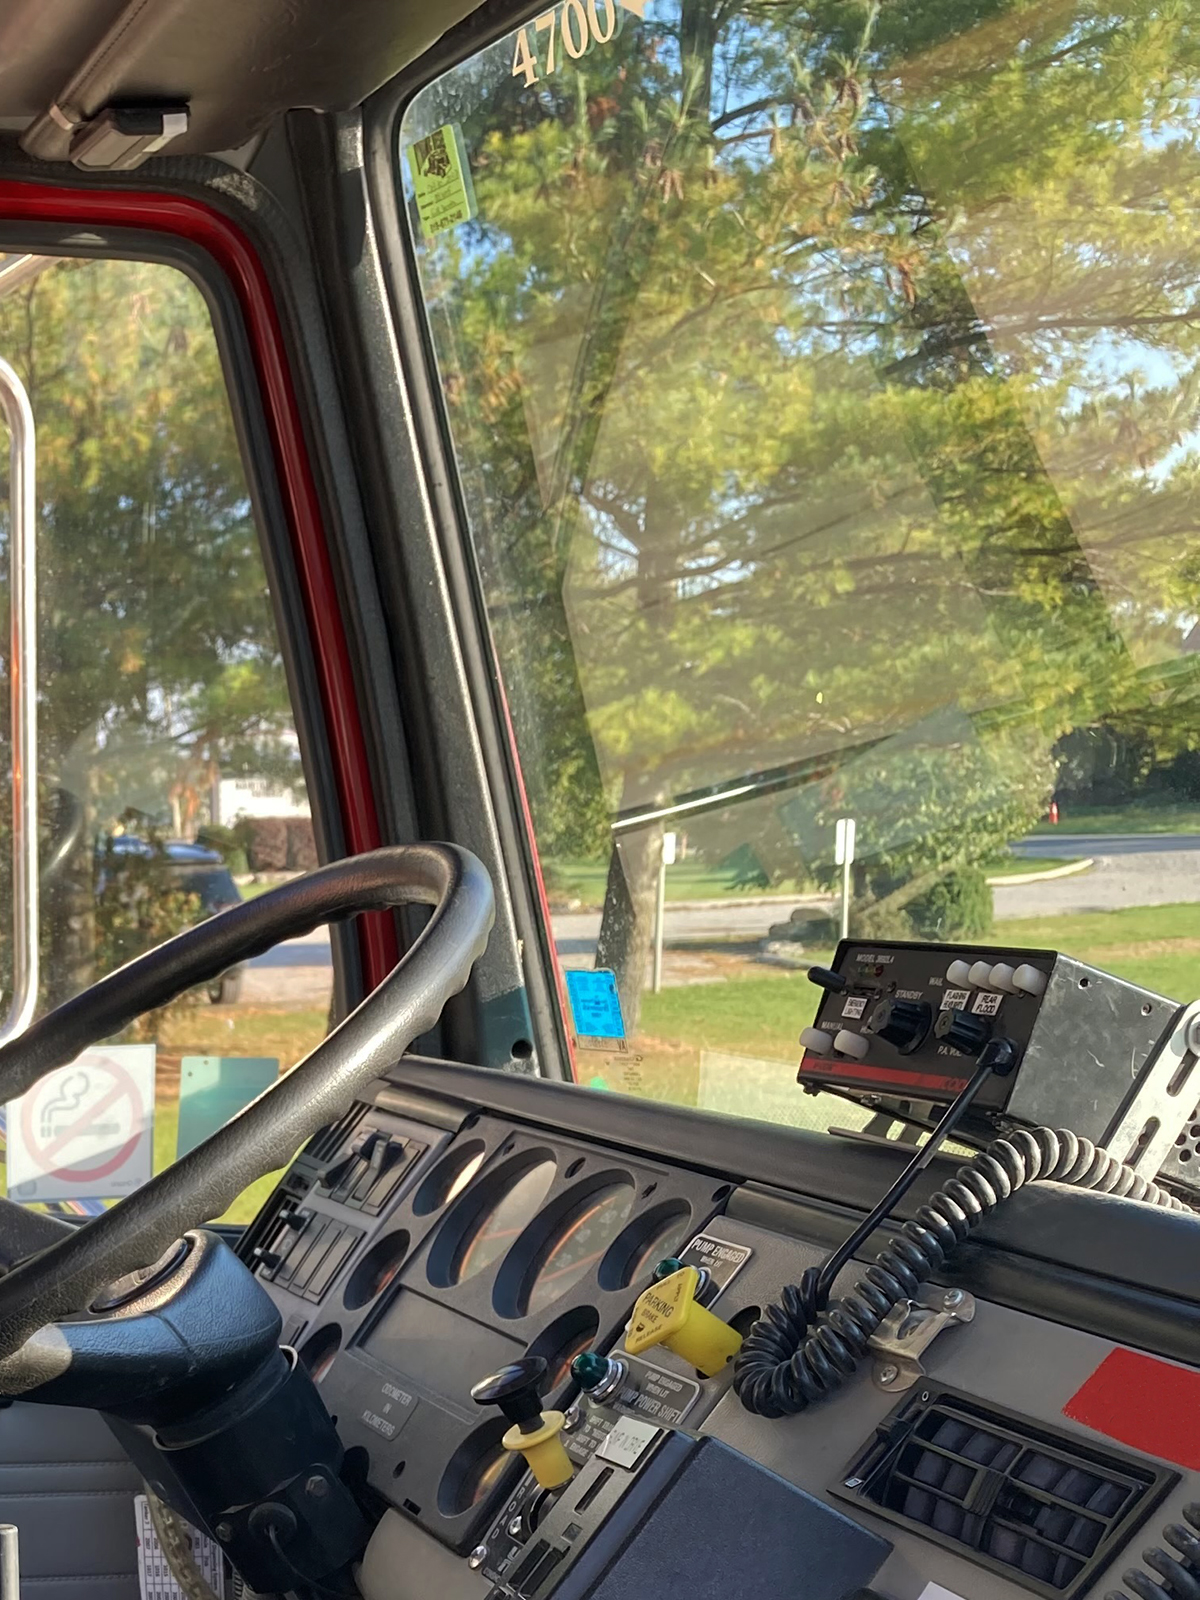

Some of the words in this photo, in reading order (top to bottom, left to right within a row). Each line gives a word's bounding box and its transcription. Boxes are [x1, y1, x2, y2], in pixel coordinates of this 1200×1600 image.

[512, 0, 615, 88] 4700
[894, 989, 923, 1000] STANDBY
[981, 994, 998, 1004] REAR
[975, 1004, 996, 1014] FLOOD
[691, 1239, 716, 1254] PUMP
[711, 1246, 745, 1263] ENGAGED
[641, 1308, 659, 1323] BRAKE
[642, 1292, 675, 1318] PARKING
[381, 1383, 412, 1407] ODOMETER
[382, 1403, 393, 1414] IN
[634, 1392, 662, 1417] POWER
[658, 1404, 682, 1423] SHIFT
[361, 1409, 396, 1436] KILOMETERS
